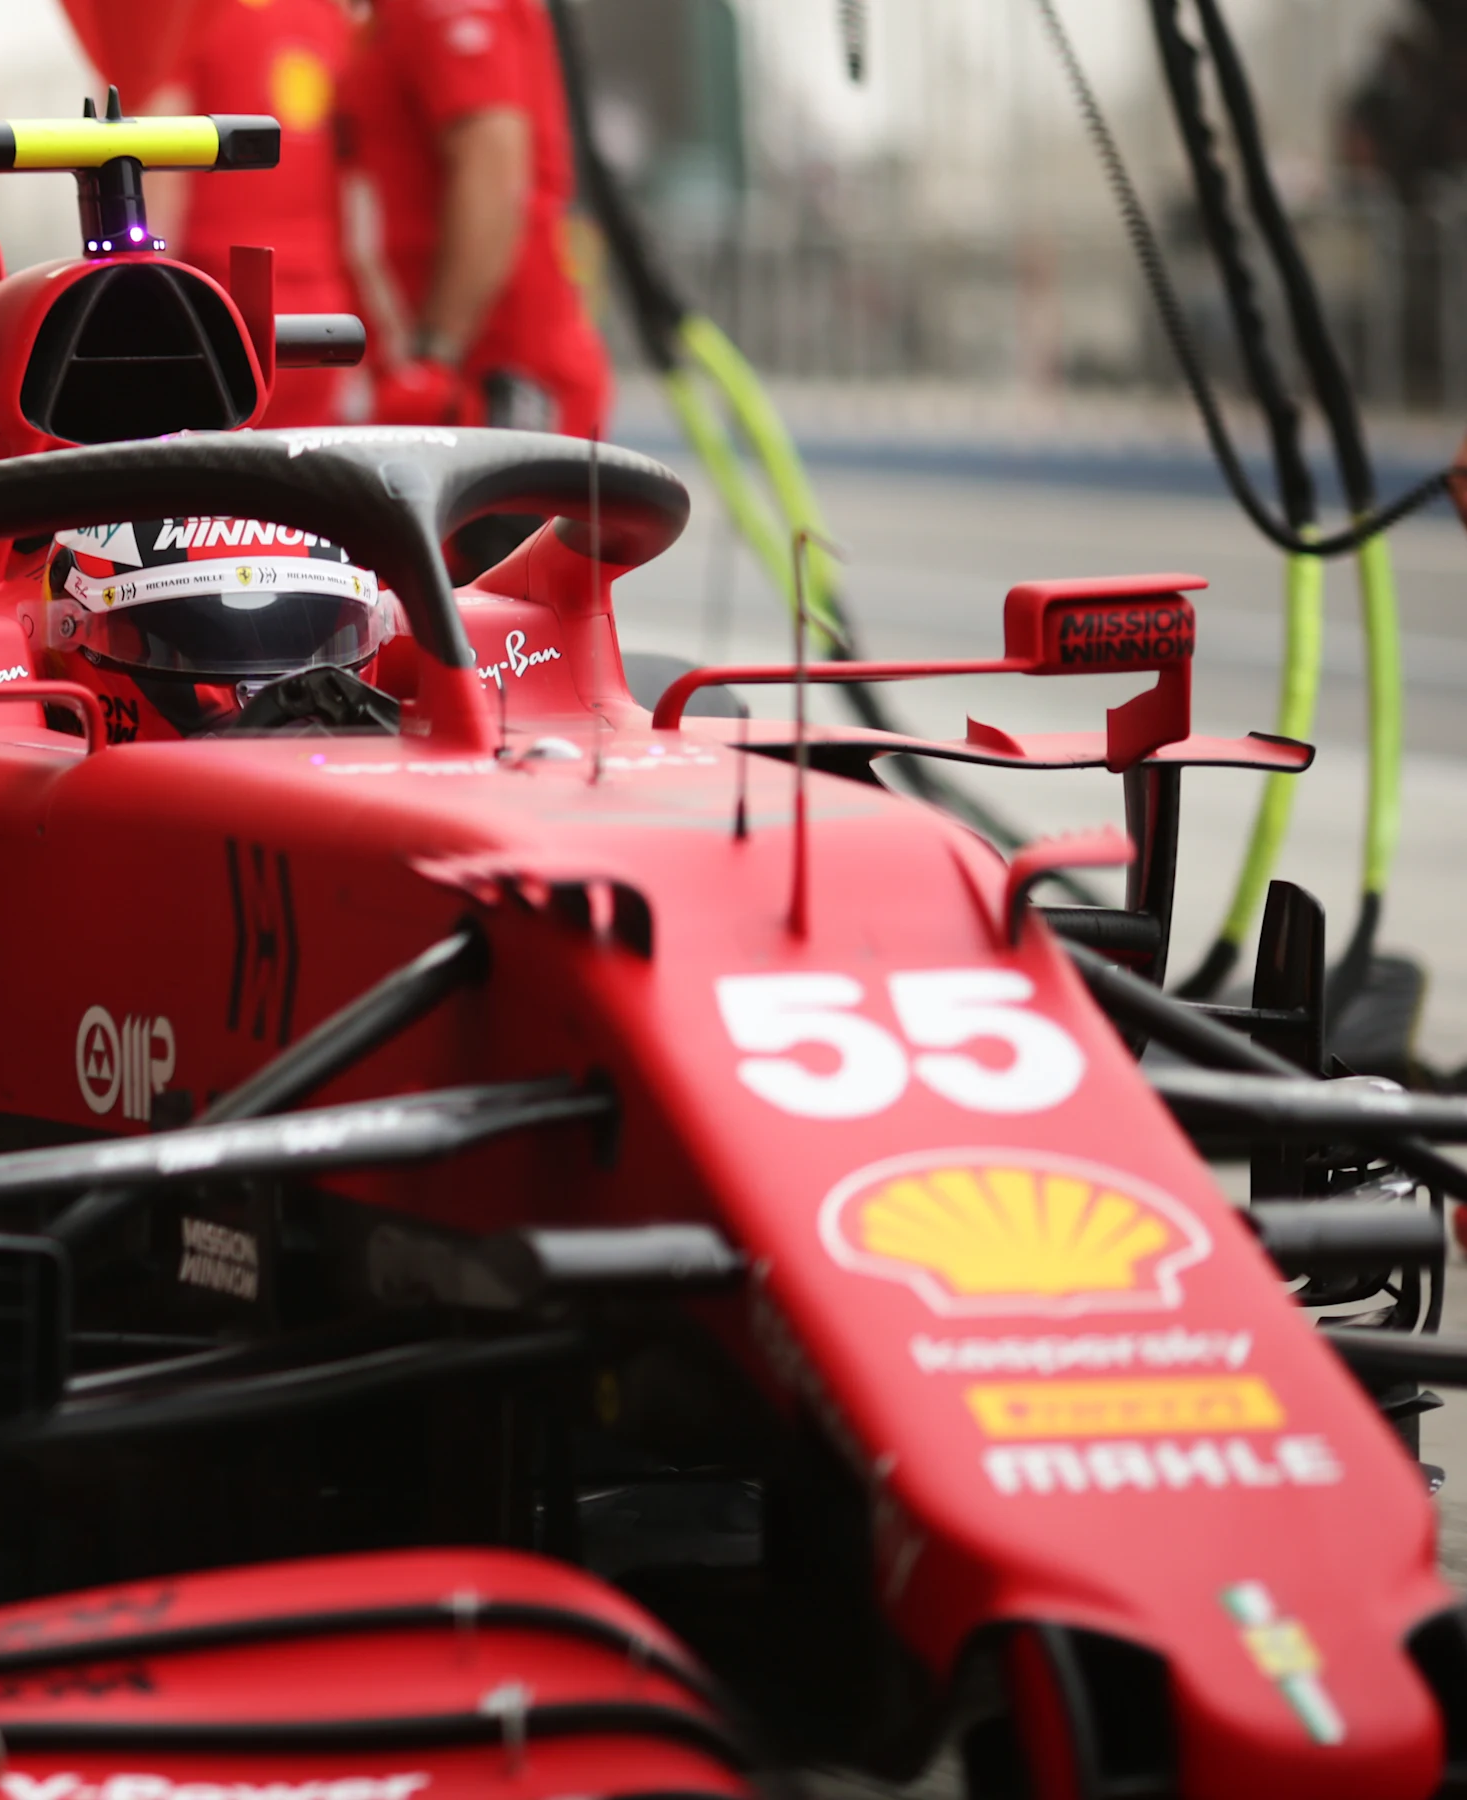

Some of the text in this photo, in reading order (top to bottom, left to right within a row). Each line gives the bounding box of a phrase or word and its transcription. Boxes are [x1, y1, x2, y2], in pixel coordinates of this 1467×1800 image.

[146, 573, 225, 591] RICHARD MILLE
[1060, 608, 1193, 641] MISSION
[715, 968, 1087, 1120] 55
[182, 1216, 258, 1266] MISSION
[984, 1435, 1343, 1493] MAHLE
